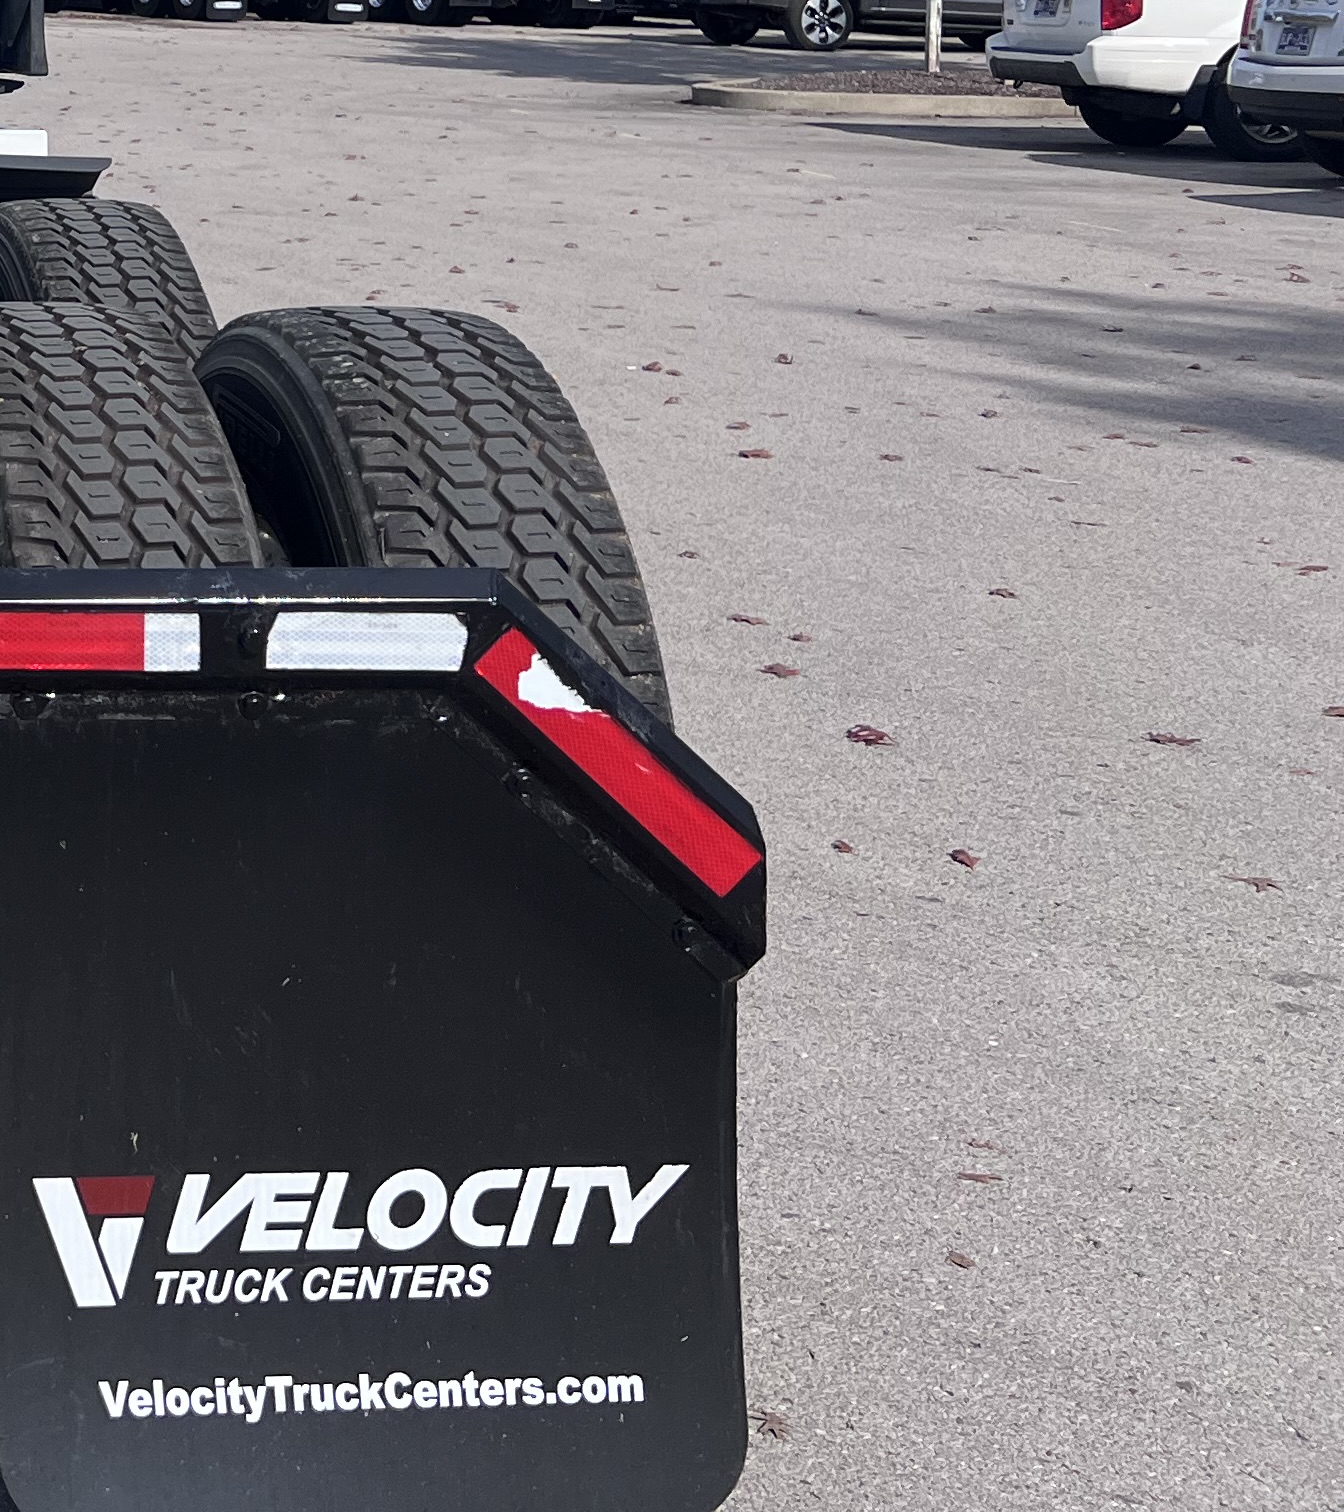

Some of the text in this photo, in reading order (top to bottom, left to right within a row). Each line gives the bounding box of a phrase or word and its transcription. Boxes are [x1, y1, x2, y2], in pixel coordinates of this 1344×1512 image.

[166, 1164, 691, 1254] VELOCITY
[154, 1262, 492, 1306] TRUCK CENTERS
[98, 1371, 644, 1424] VelocityTruckCenters.com
